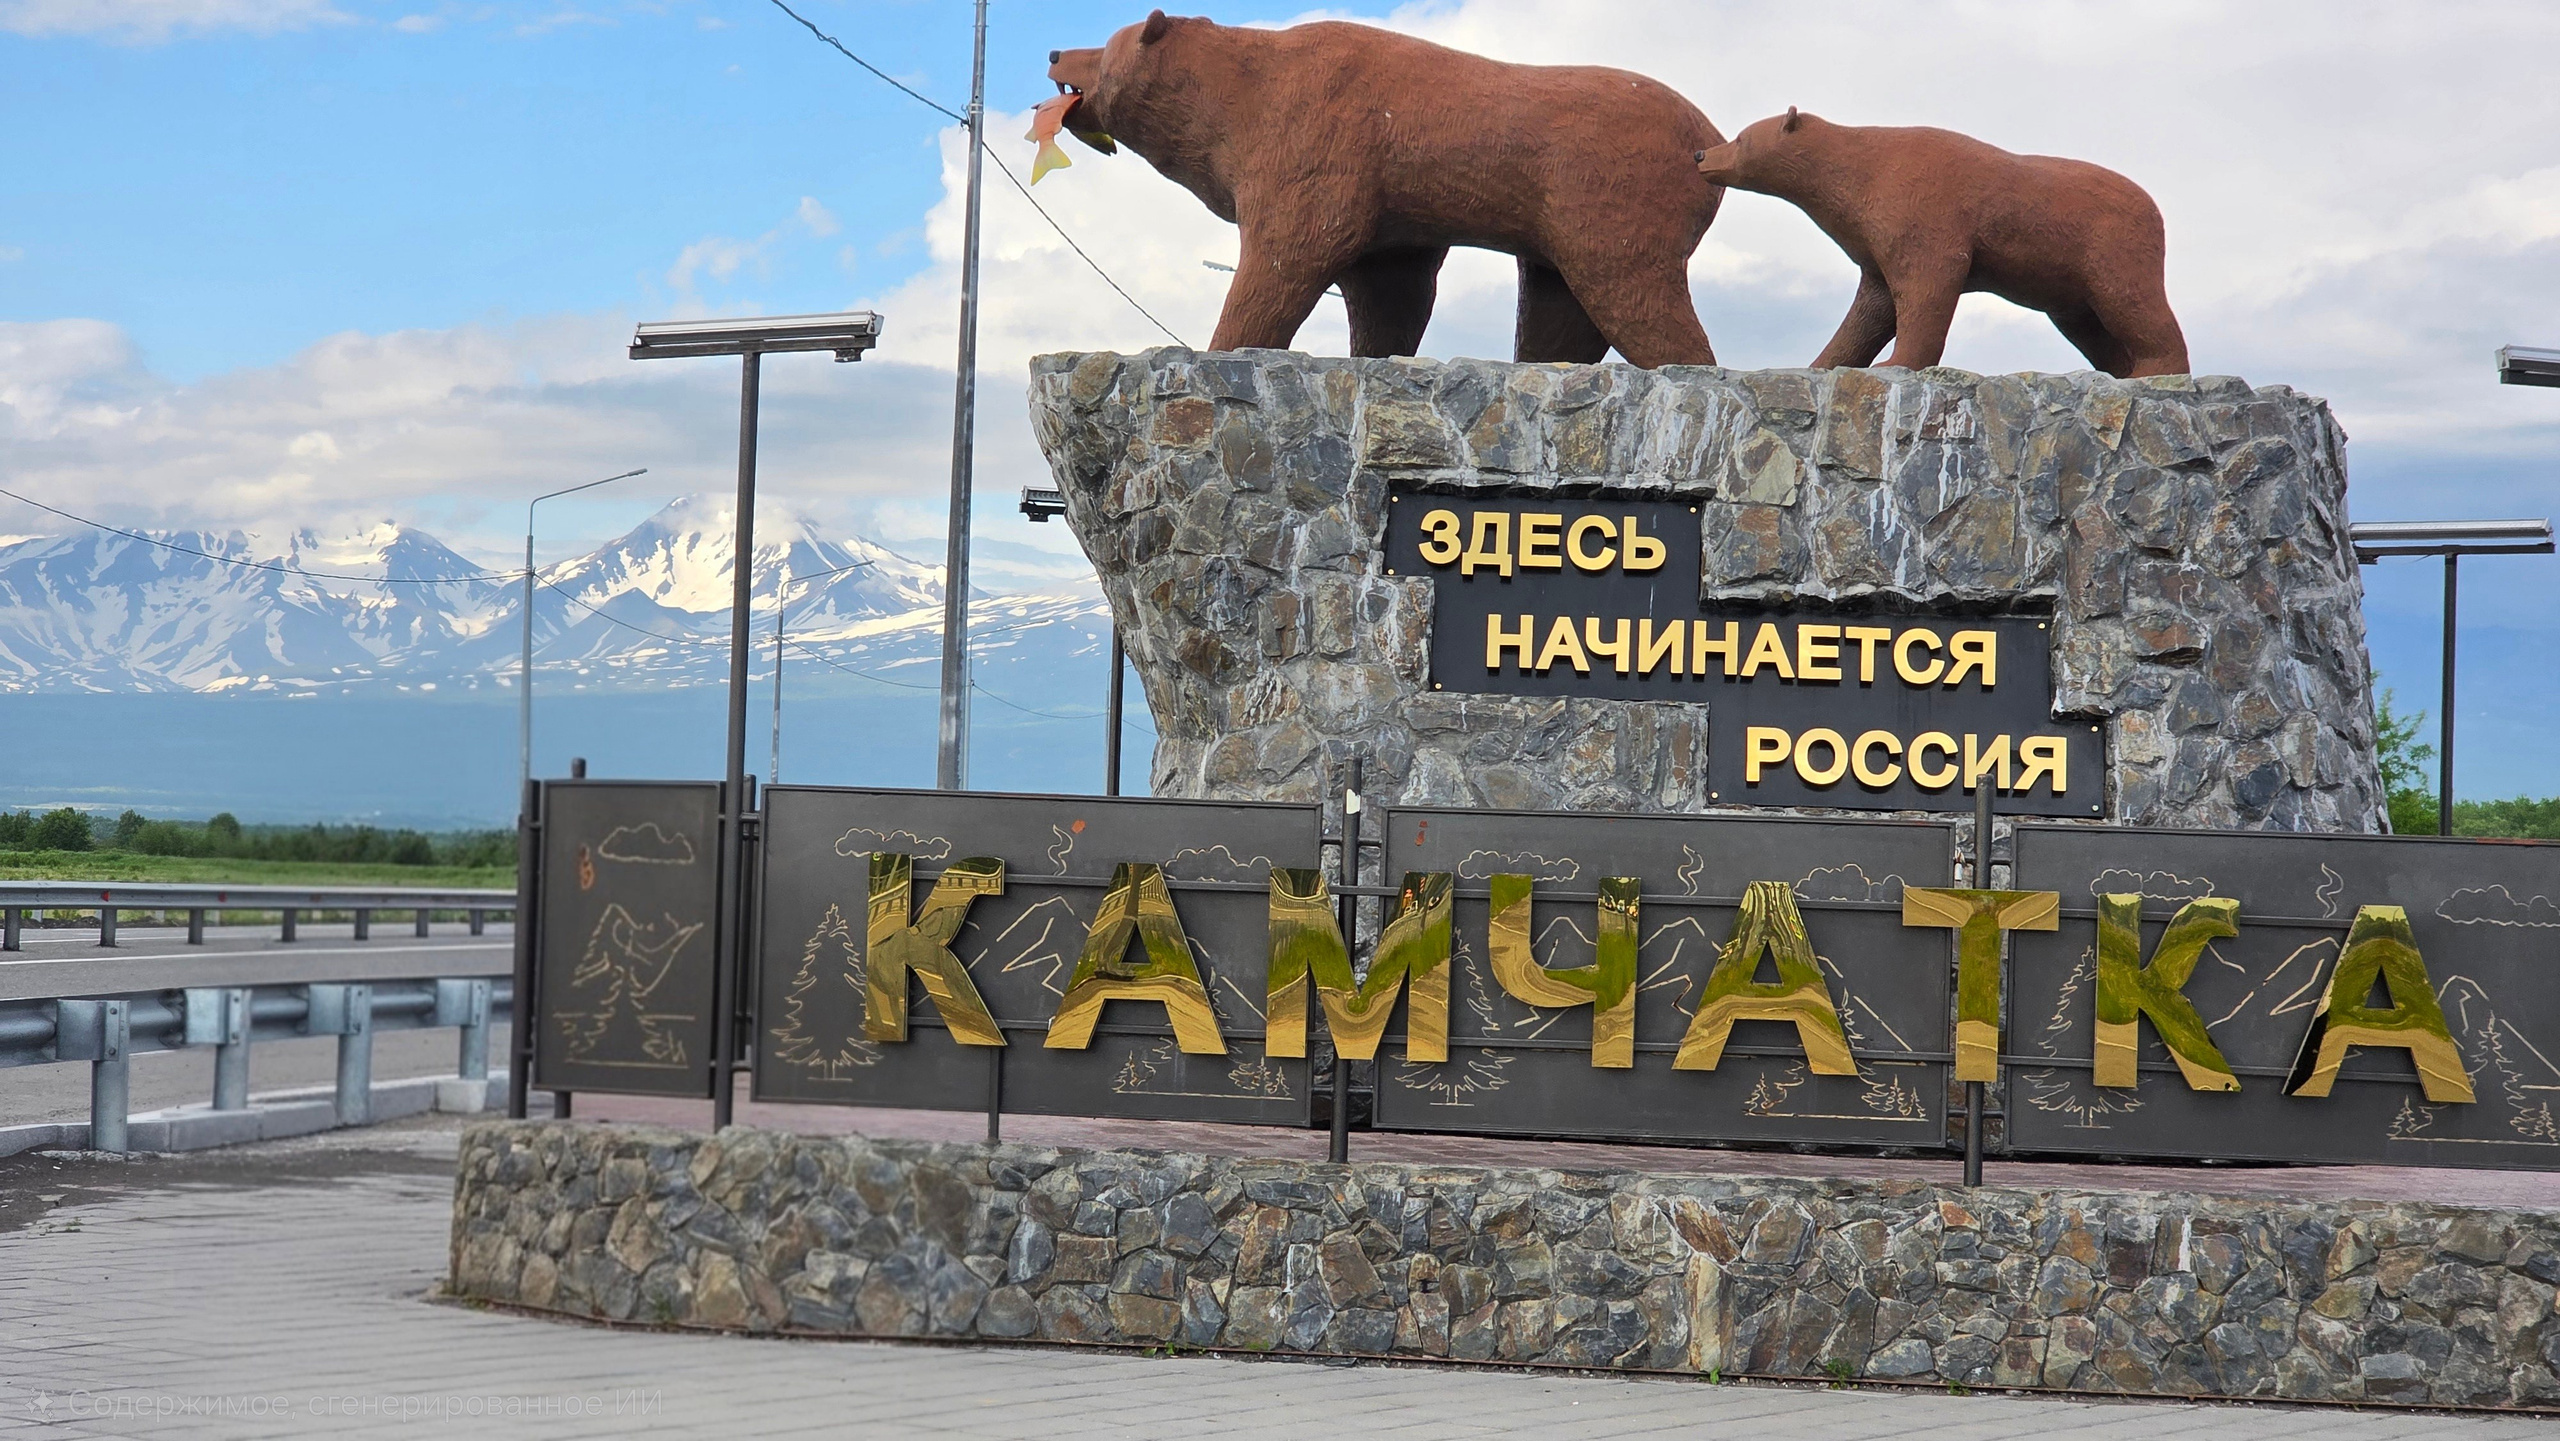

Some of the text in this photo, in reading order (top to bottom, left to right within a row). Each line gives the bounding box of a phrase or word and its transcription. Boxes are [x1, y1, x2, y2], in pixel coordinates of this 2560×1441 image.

[1419, 509, 1667, 577] ЗДЕСЬ
[1486, 613, 1998, 686] НАЧИНАЕТСЯ
[1745, 726, 2068, 792] РОССИЯ
[865, 852, 2478, 1104] КАМЧАТКА
